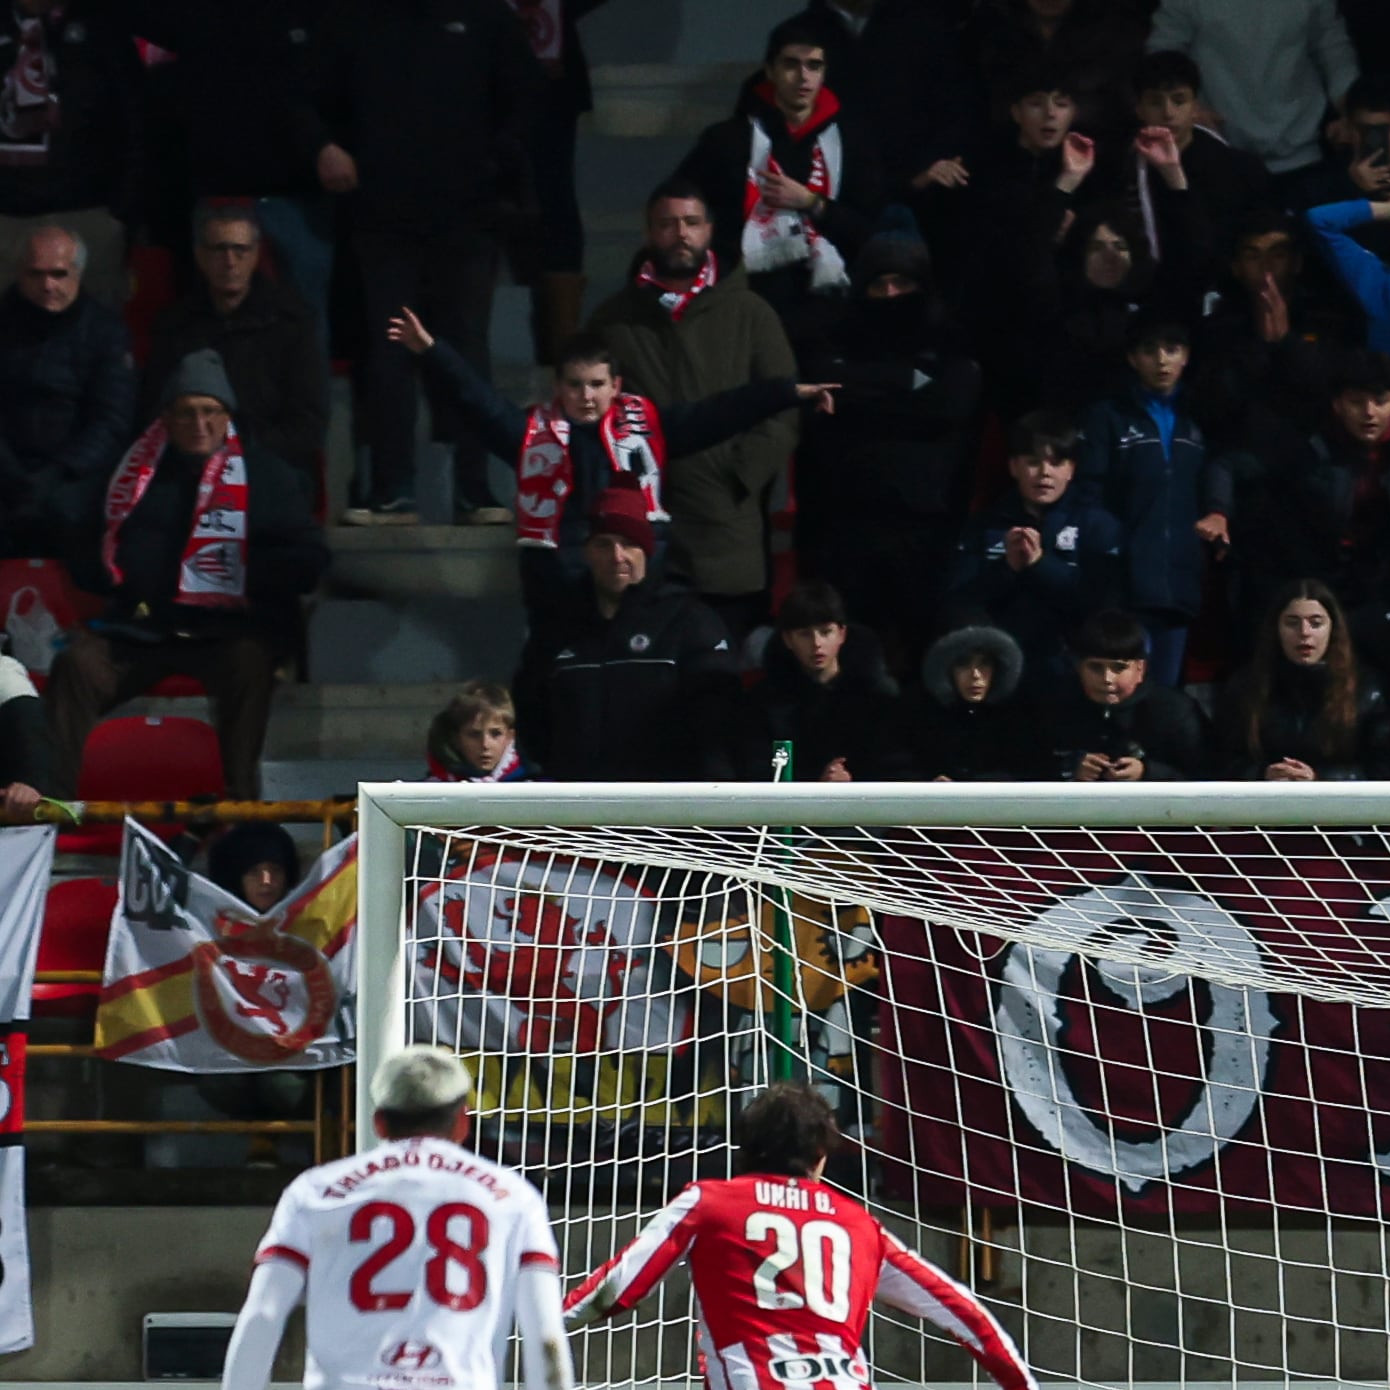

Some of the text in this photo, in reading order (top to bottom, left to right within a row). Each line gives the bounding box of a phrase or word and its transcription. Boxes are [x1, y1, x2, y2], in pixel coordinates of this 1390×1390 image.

[755, 1181, 809, 1212] UNAI
[349, 1201, 490, 1313] 28
[745, 1211, 852, 1324] 20
